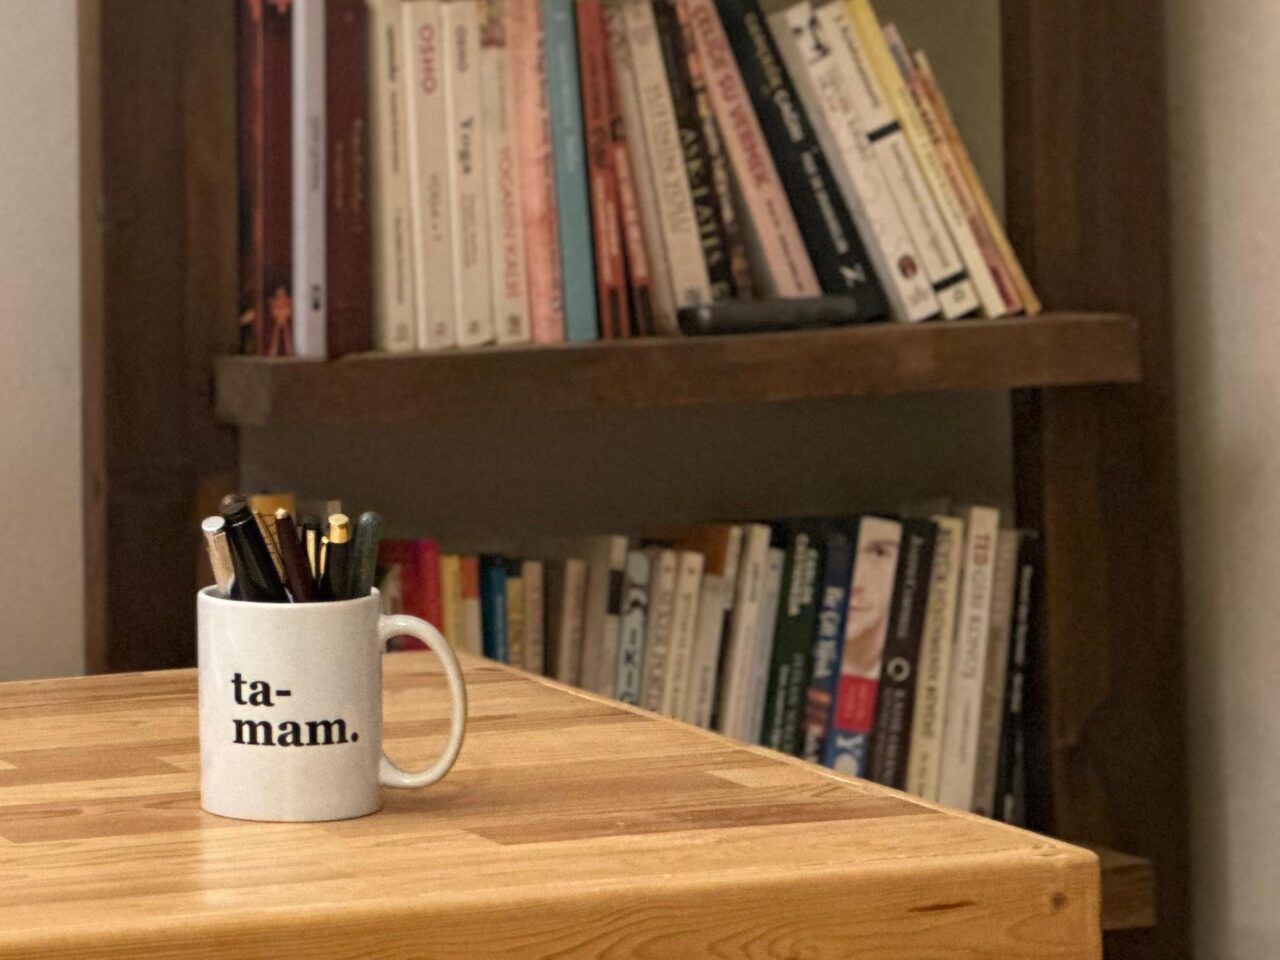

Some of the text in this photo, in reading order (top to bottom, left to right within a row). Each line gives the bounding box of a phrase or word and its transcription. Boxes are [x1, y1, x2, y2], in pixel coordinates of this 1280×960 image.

[417, 23, 439, 94] OSHO
[231, 672, 292, 707] ta-
[233, 718, 360, 747] mam.
